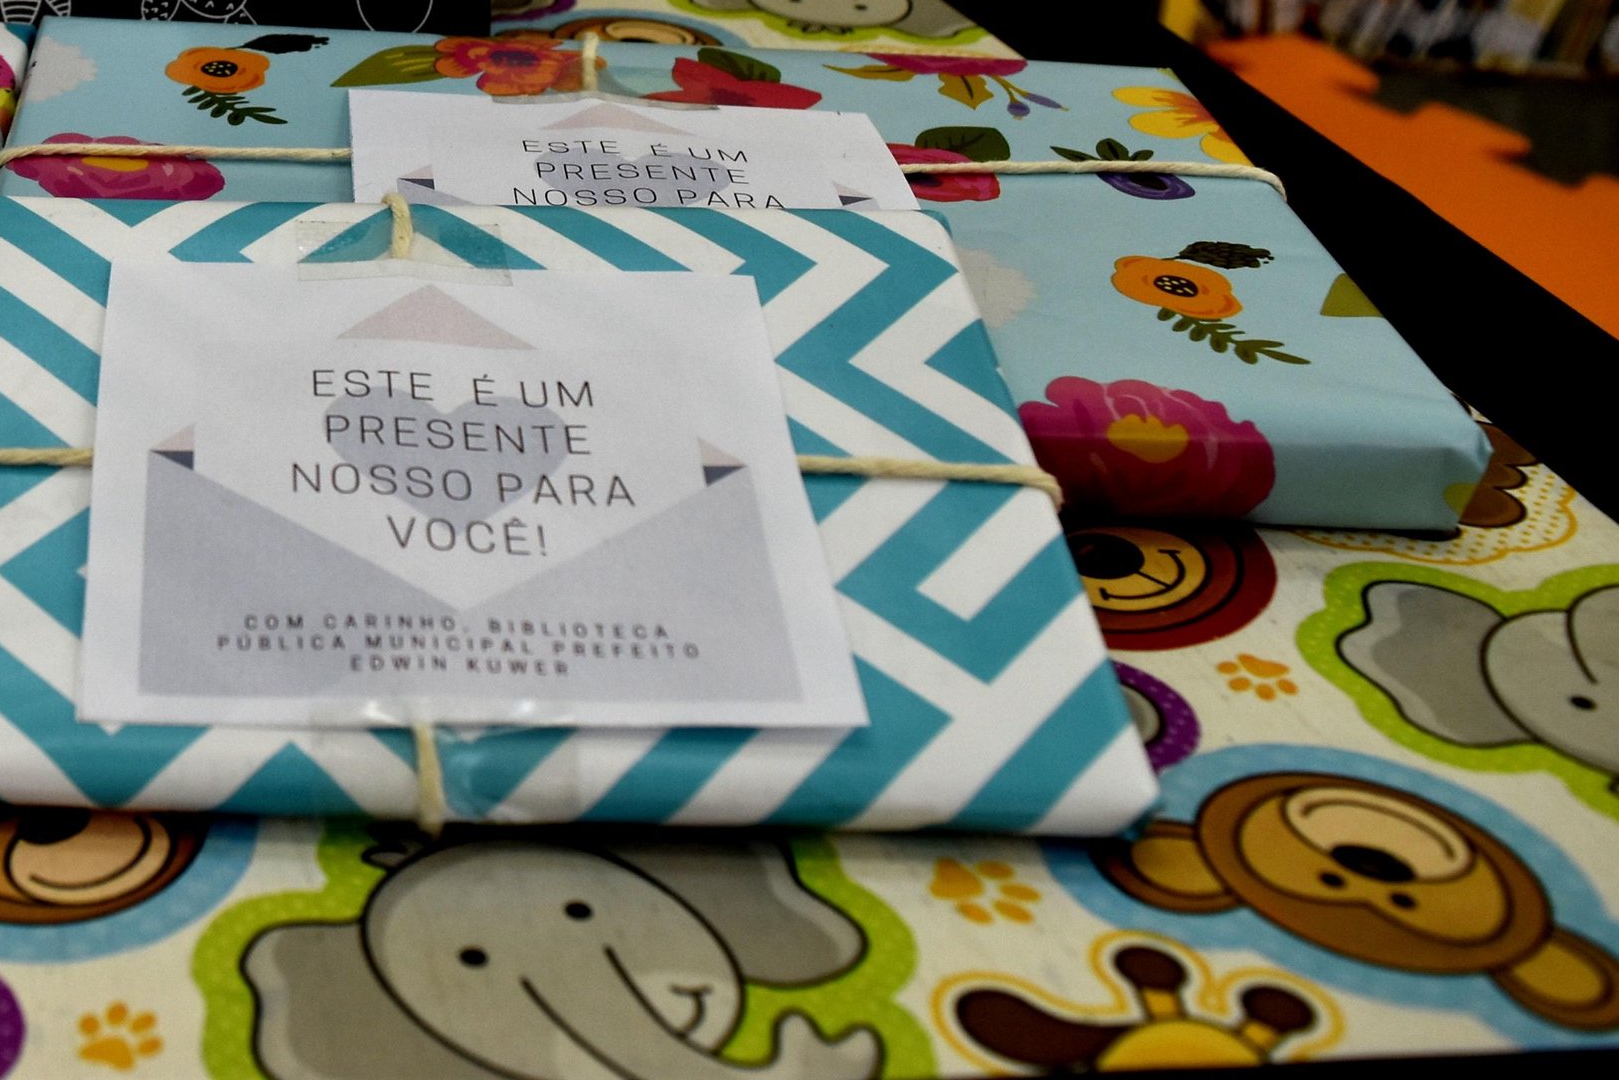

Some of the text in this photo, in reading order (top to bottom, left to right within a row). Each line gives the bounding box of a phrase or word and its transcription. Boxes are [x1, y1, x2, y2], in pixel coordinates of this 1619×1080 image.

[522, 139, 749, 164] ESTE É UM
[536, 161, 750, 185] PRESENTE
[513, 187, 786, 209] NOSSO PARA
[312, 369, 594, 408] ESTE É UM
[325, 414, 592, 455] PRESENTE
[291, 462, 636, 507] NOSSO PARA
[387, 516, 547, 557] VOCÊ!
[244, 614, 303, 631] COM
[488, 618, 669, 640] BIBLIOTECA
[365, 634, 531, 655] MUNICIPAL
[551, 640, 700, 659] PREFEITO
[350, 653, 569, 676] EDWIN KUWER
